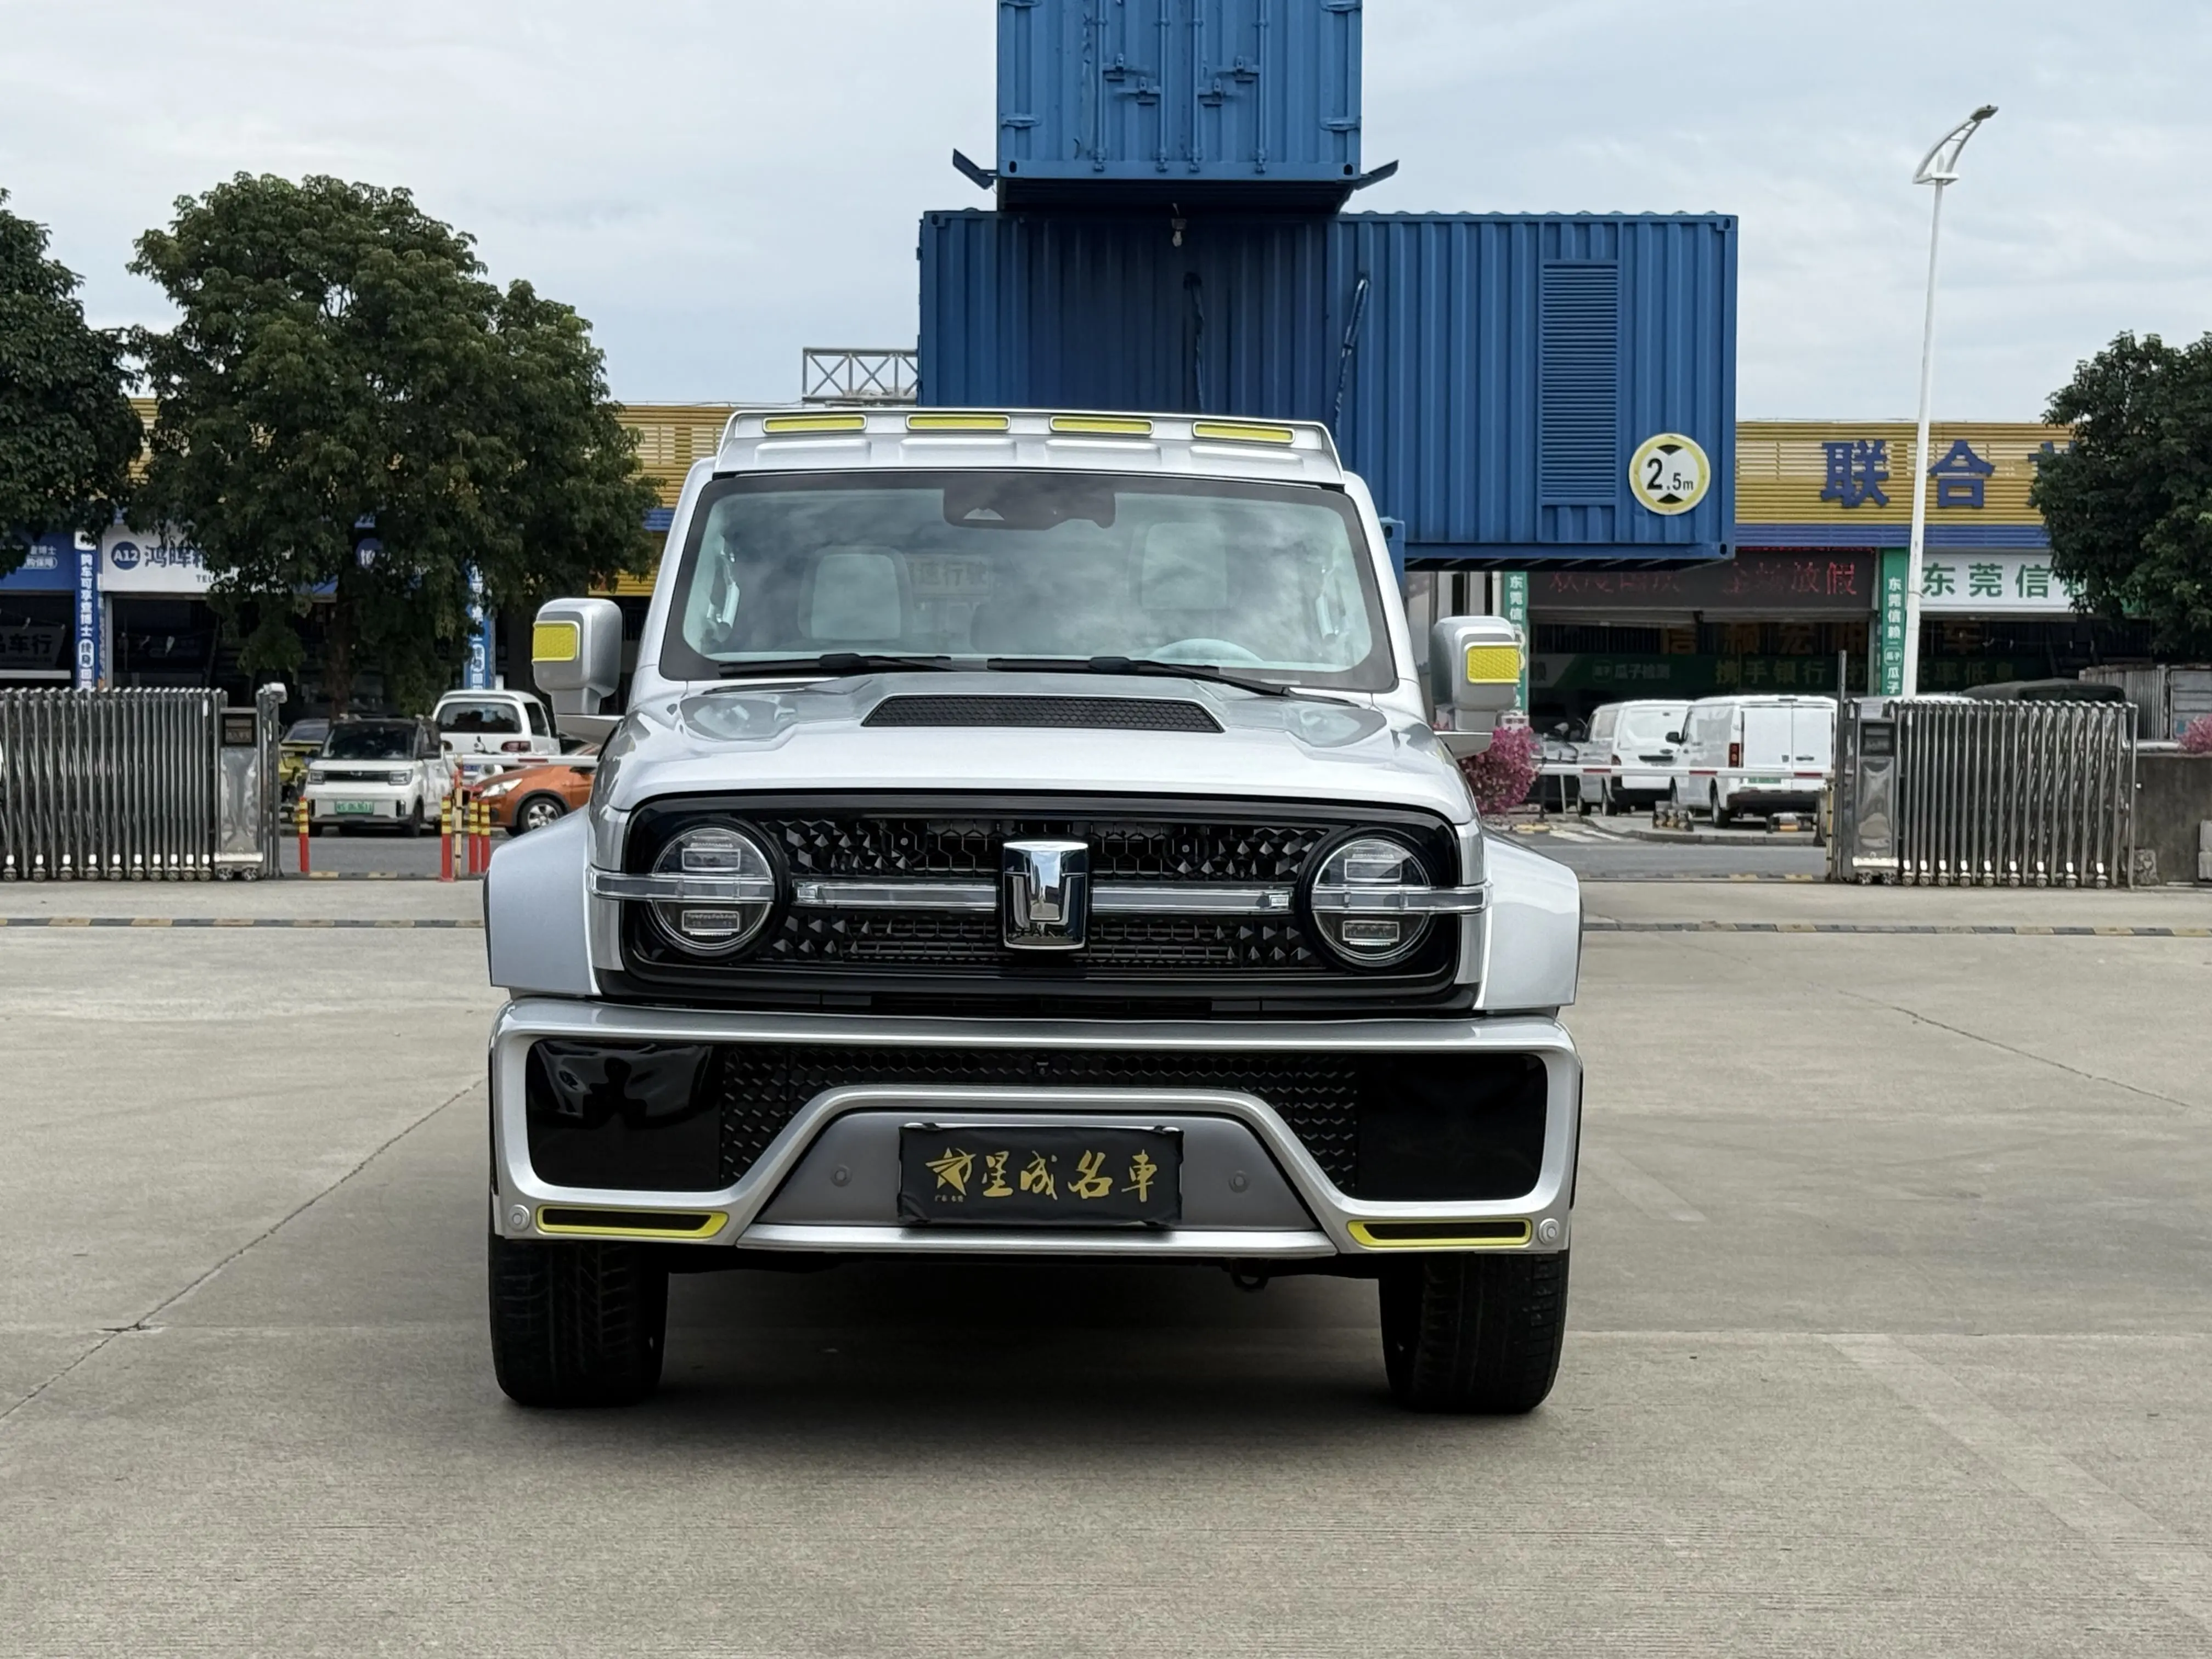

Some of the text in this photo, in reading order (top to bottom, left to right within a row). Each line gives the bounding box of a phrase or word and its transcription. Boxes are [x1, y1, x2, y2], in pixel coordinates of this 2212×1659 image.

[1647, 458, 1694, 490] 2.5m
[1821, 439, 2078, 508] 联合
[114, 550, 138, 561] A12
